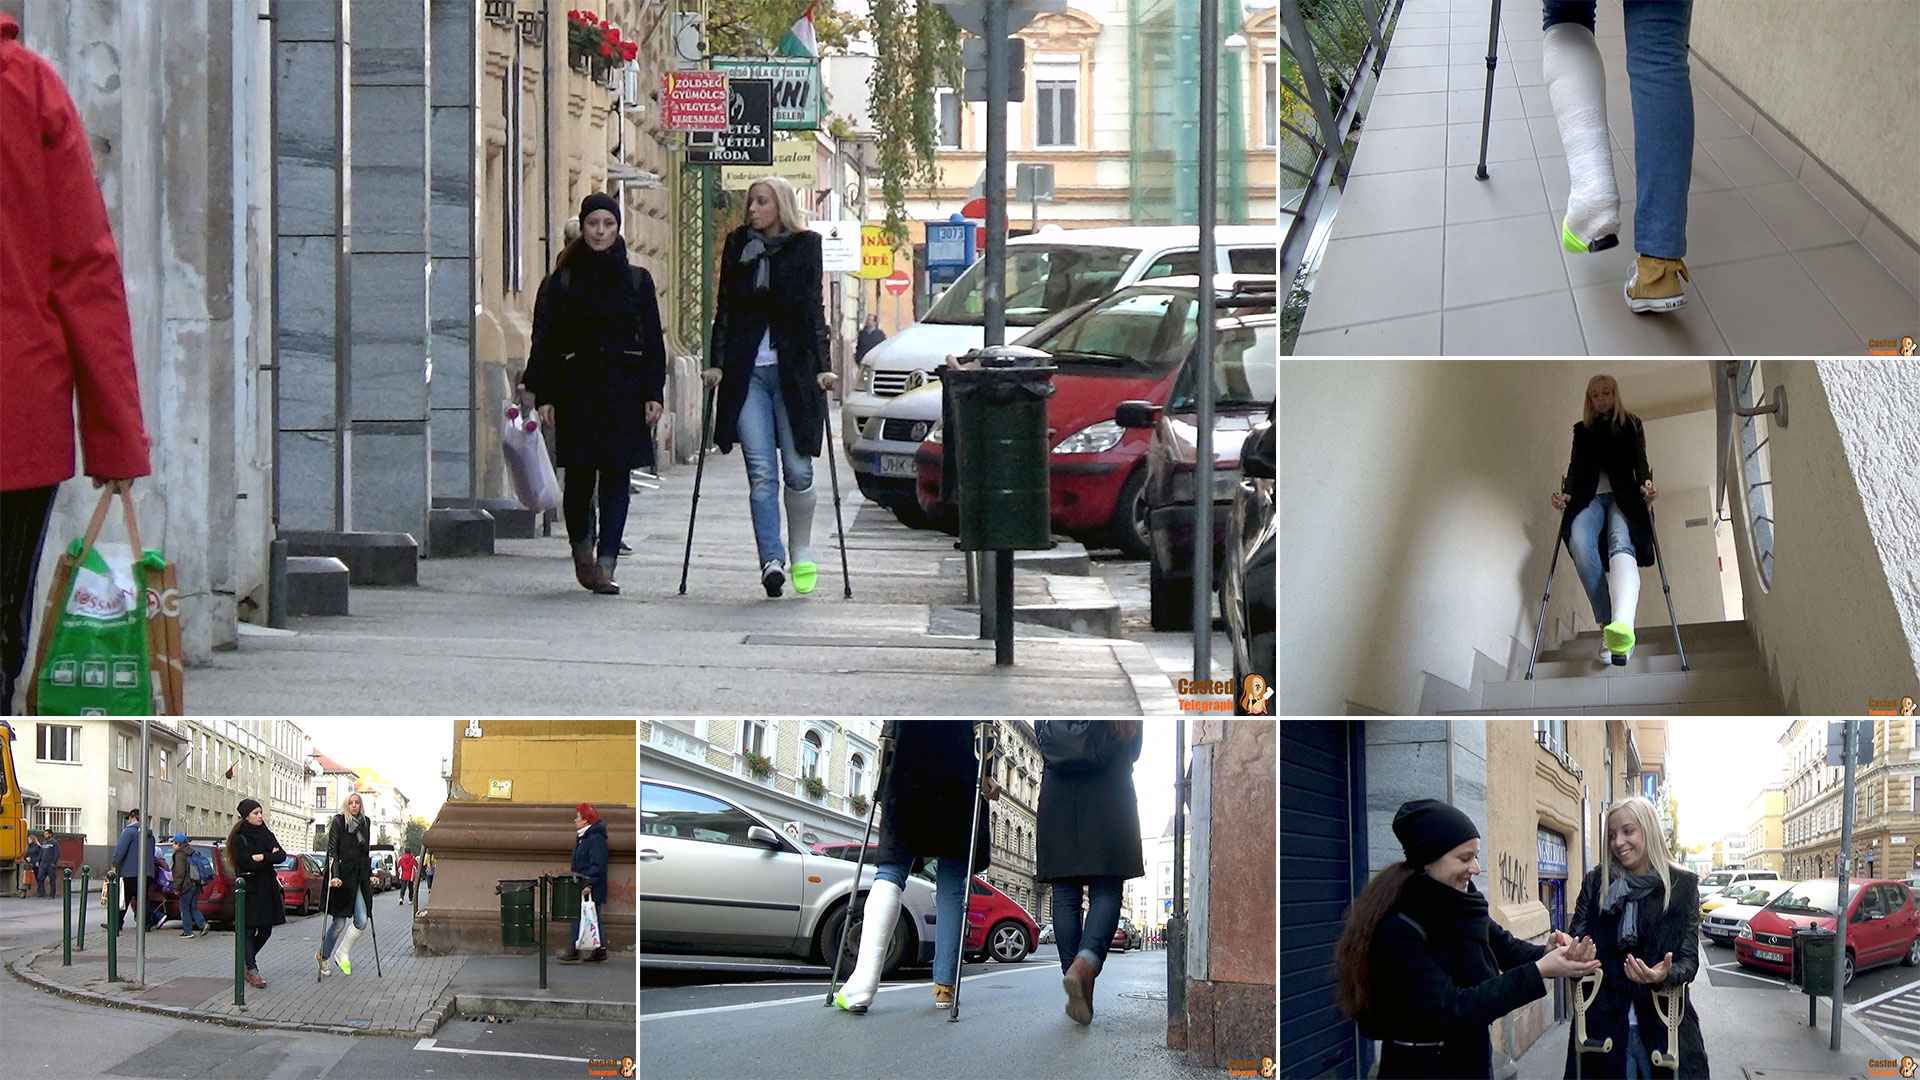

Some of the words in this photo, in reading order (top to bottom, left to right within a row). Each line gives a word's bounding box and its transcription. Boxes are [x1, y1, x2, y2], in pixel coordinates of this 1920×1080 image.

[772, 80, 810, 108] KNI
[680, 102, 717, 112] VEGYES
[725, 122, 761, 134] ETÉS
[709, 150, 750, 160] IRODA
[940, 227, 964, 239] 3073
